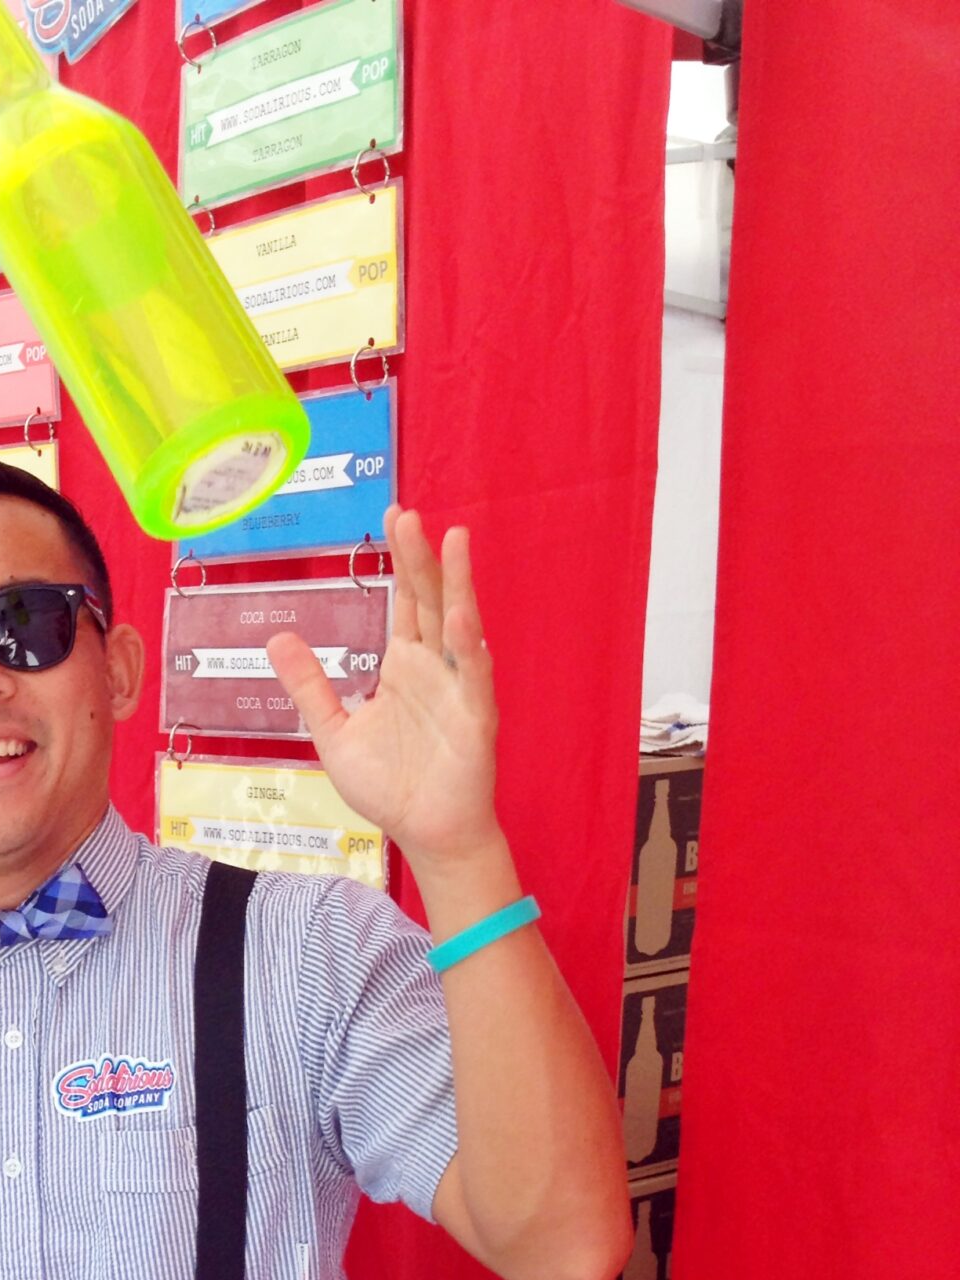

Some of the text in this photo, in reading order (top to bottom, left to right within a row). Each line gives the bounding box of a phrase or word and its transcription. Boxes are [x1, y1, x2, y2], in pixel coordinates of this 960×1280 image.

[251, 39, 302, 70] TARRAGON
[190, 57, 389, 146] HIT WWW.SODALIRIOUS.COM POP
[252, 134, 303, 163] TARRAGON
[256, 234, 297, 258] VANILLA
[244, 260, 388, 310] SODALIRIOUS.COM POP
[26, 345, 47, 363] POP
[355, 456, 385, 478] POP
[242, 512, 301, 532] BLUEBERRY
[240, 610, 297, 625] COCA COLA
[175, 654, 192, 672] HIT
[350, 653, 379, 671] POP
[236, 696, 295, 711] COCA COLA
[246, 786, 286, 801] GINGER
[170, 820, 375, 855] HIT WWW.SODALIRIOUS.COM POP
[87, 1092, 160, 1113] SODA COMPANY
